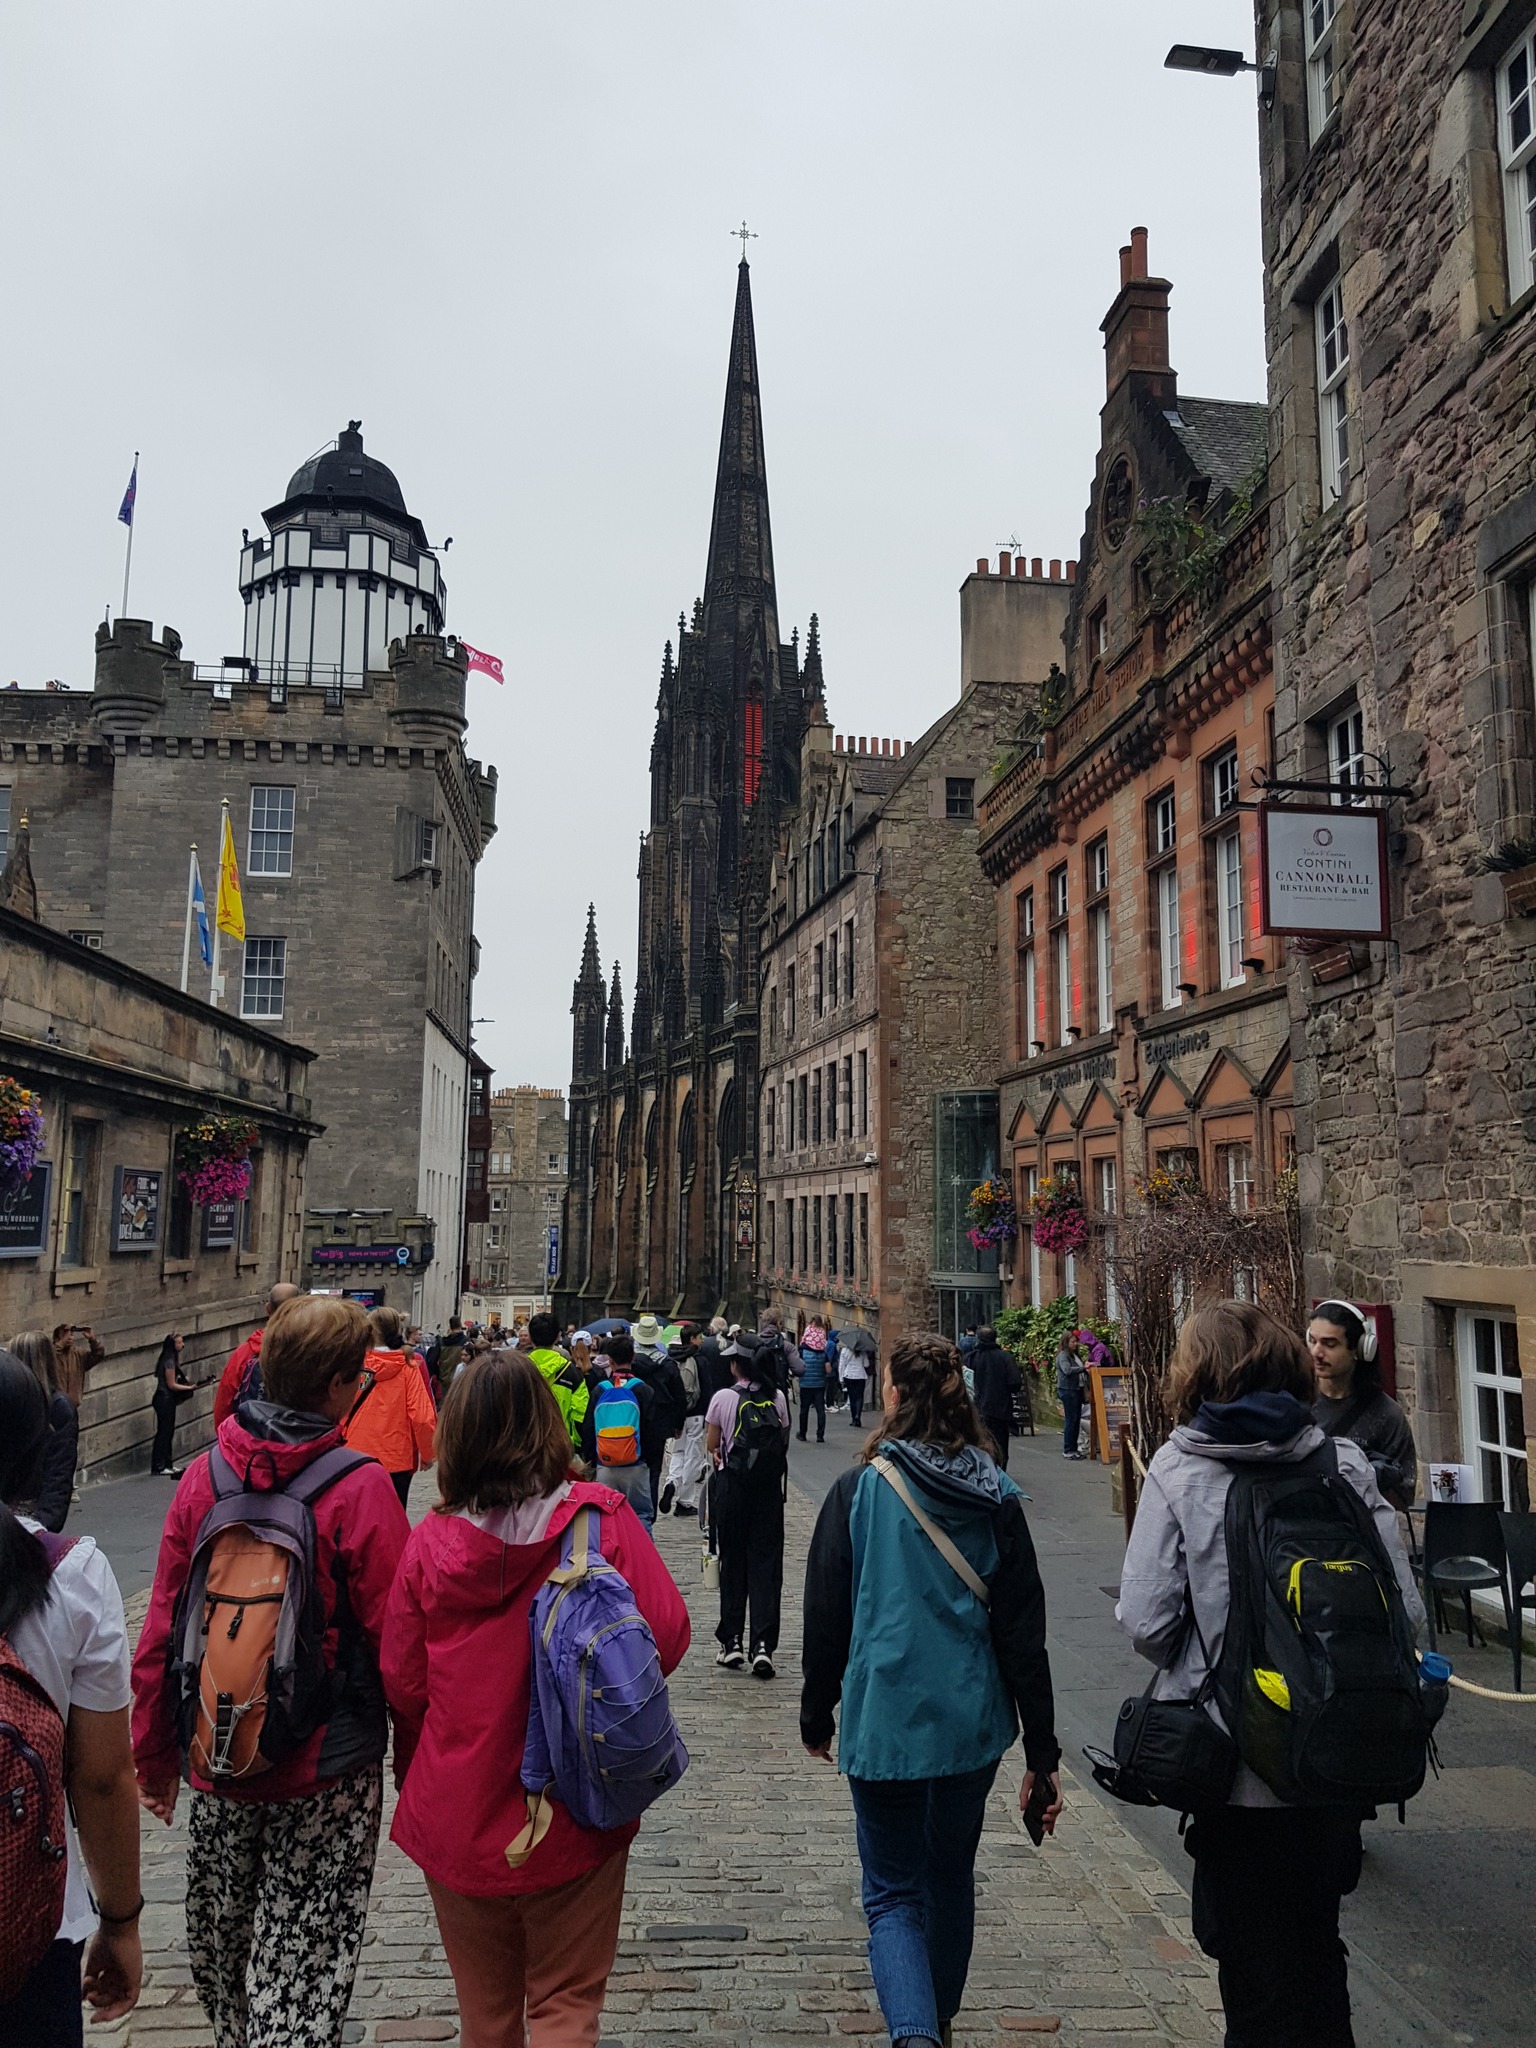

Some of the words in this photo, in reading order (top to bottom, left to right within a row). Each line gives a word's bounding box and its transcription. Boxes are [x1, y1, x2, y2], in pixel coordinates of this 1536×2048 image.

[1092, 684, 1111, 715] HILL
[1297, 858, 1352, 869] CONTINI
[1275, 870, 1374, 885] CANNONBALL
[1280, 884, 1339, 895] RESTAURANT
[1351, 887, 1370, 895] BAR
[1144, 1029, 1210, 1064] Experience
[1082, 1055, 1117, 1081] Whisky
[1322, 1562, 1353, 1573] Targus
